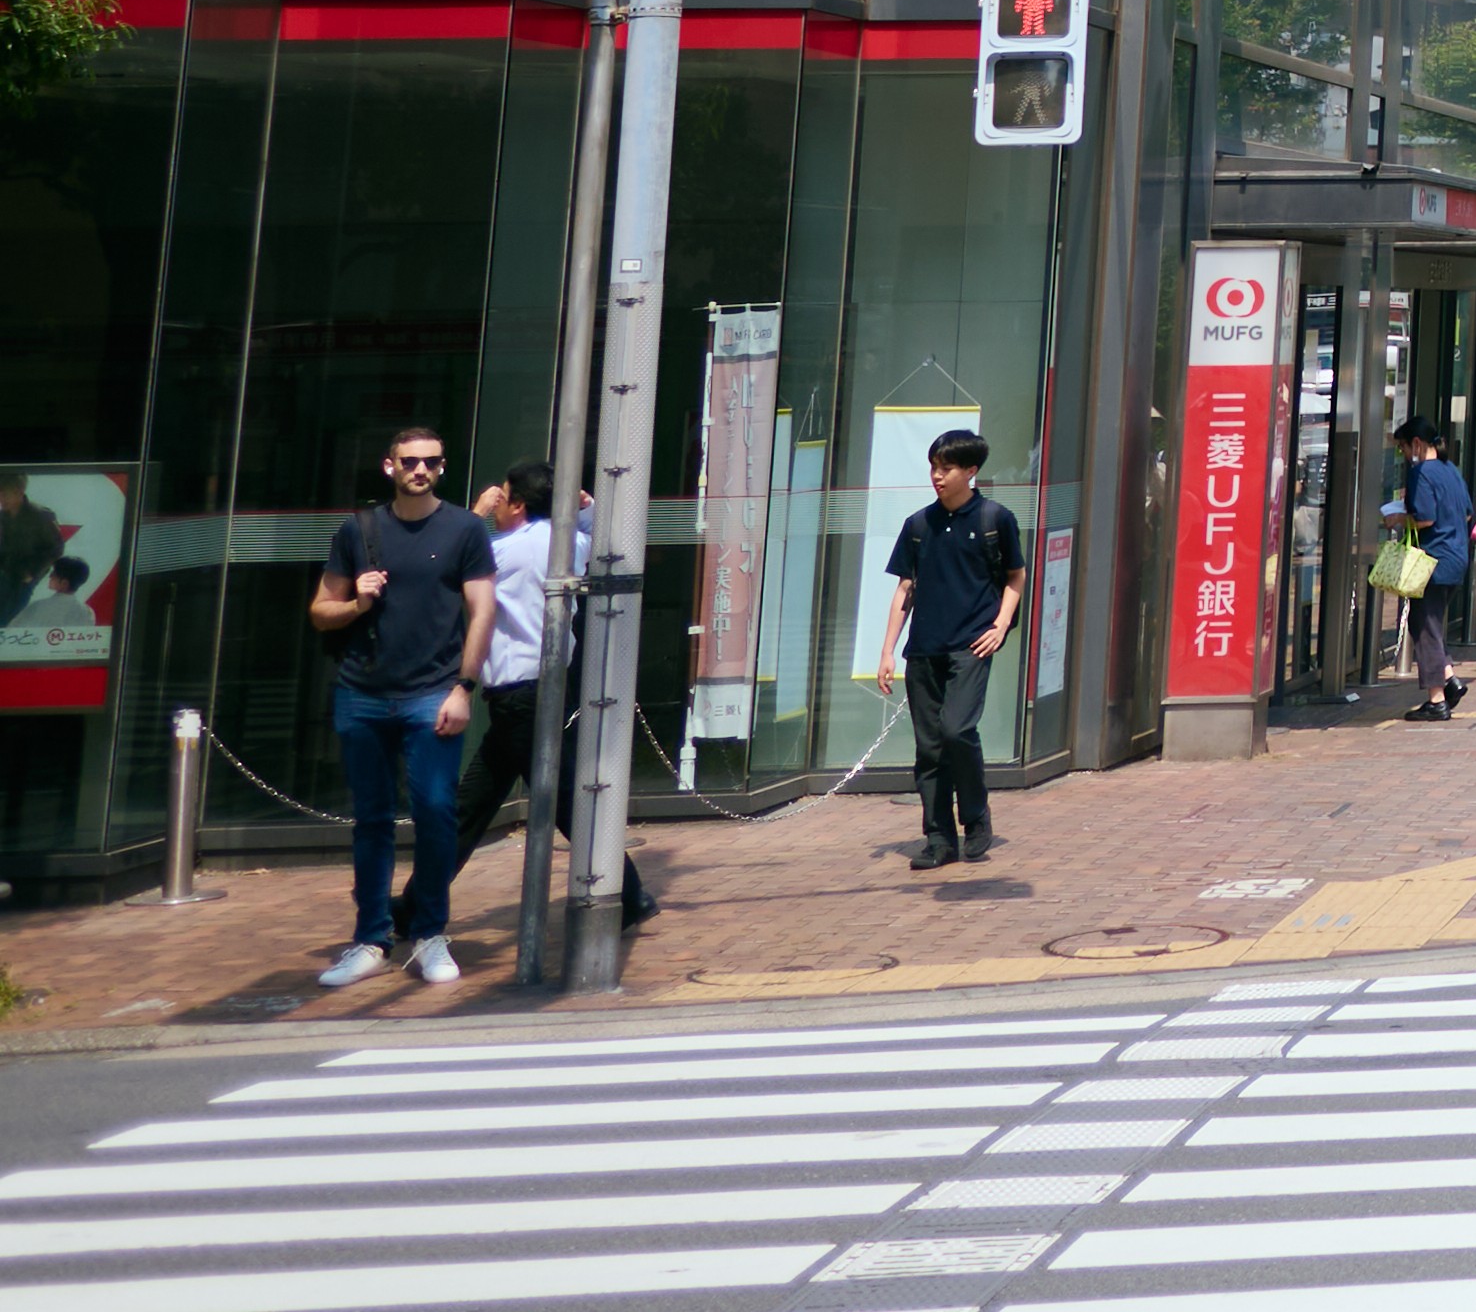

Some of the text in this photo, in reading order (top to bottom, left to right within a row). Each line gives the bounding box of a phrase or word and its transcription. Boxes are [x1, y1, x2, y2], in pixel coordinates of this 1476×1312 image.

[1203, 325, 1264, 342] MUFG
[1193, 392, 1247, 658] 三菱UFJ銀行
